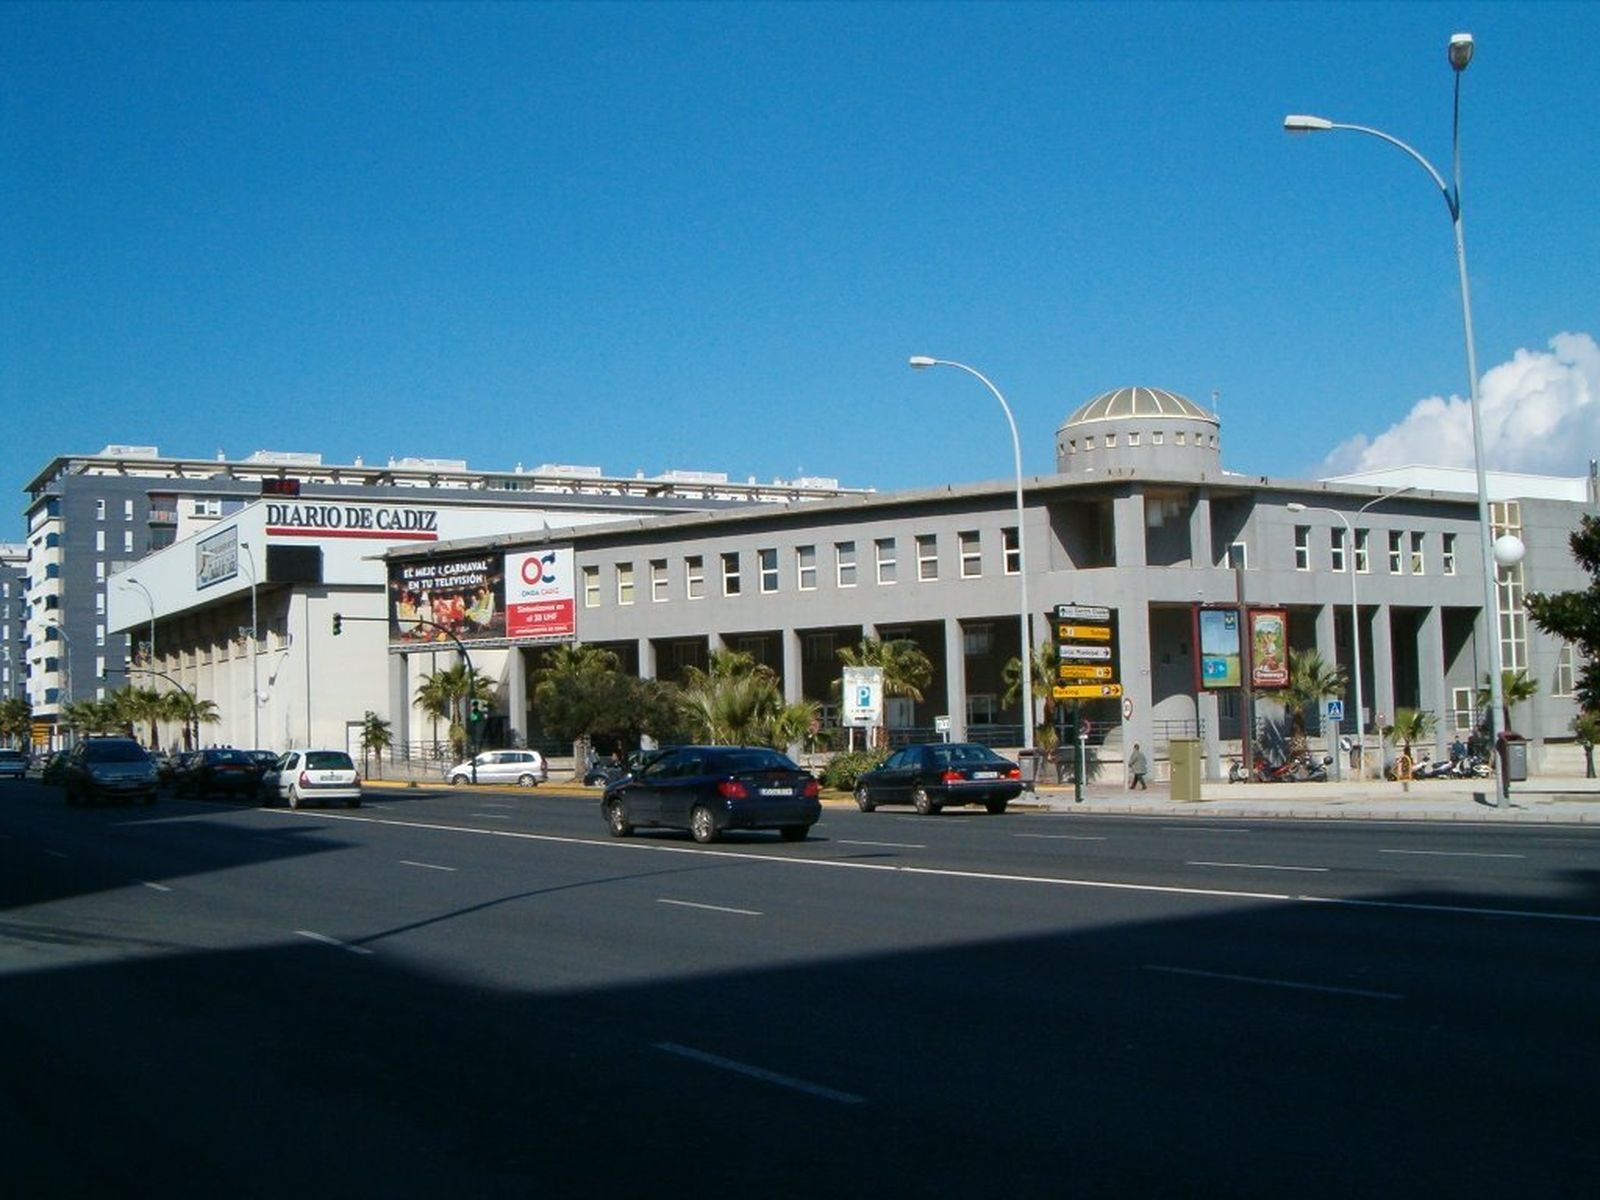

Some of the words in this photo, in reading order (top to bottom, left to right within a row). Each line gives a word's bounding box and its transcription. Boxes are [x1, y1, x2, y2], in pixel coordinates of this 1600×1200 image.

[265, 504, 341, 528] DIARIO
[345, 507, 373, 530] DE
[403, 568, 413, 578] EL
[444, 561, 488, 574] CARNAVAL
[521, 551, 556, 585] OC
[408, 580, 420, 590] EN
[421, 579, 433, 588] TU
[435, 573, 483, 588] TELEVISIÓN
